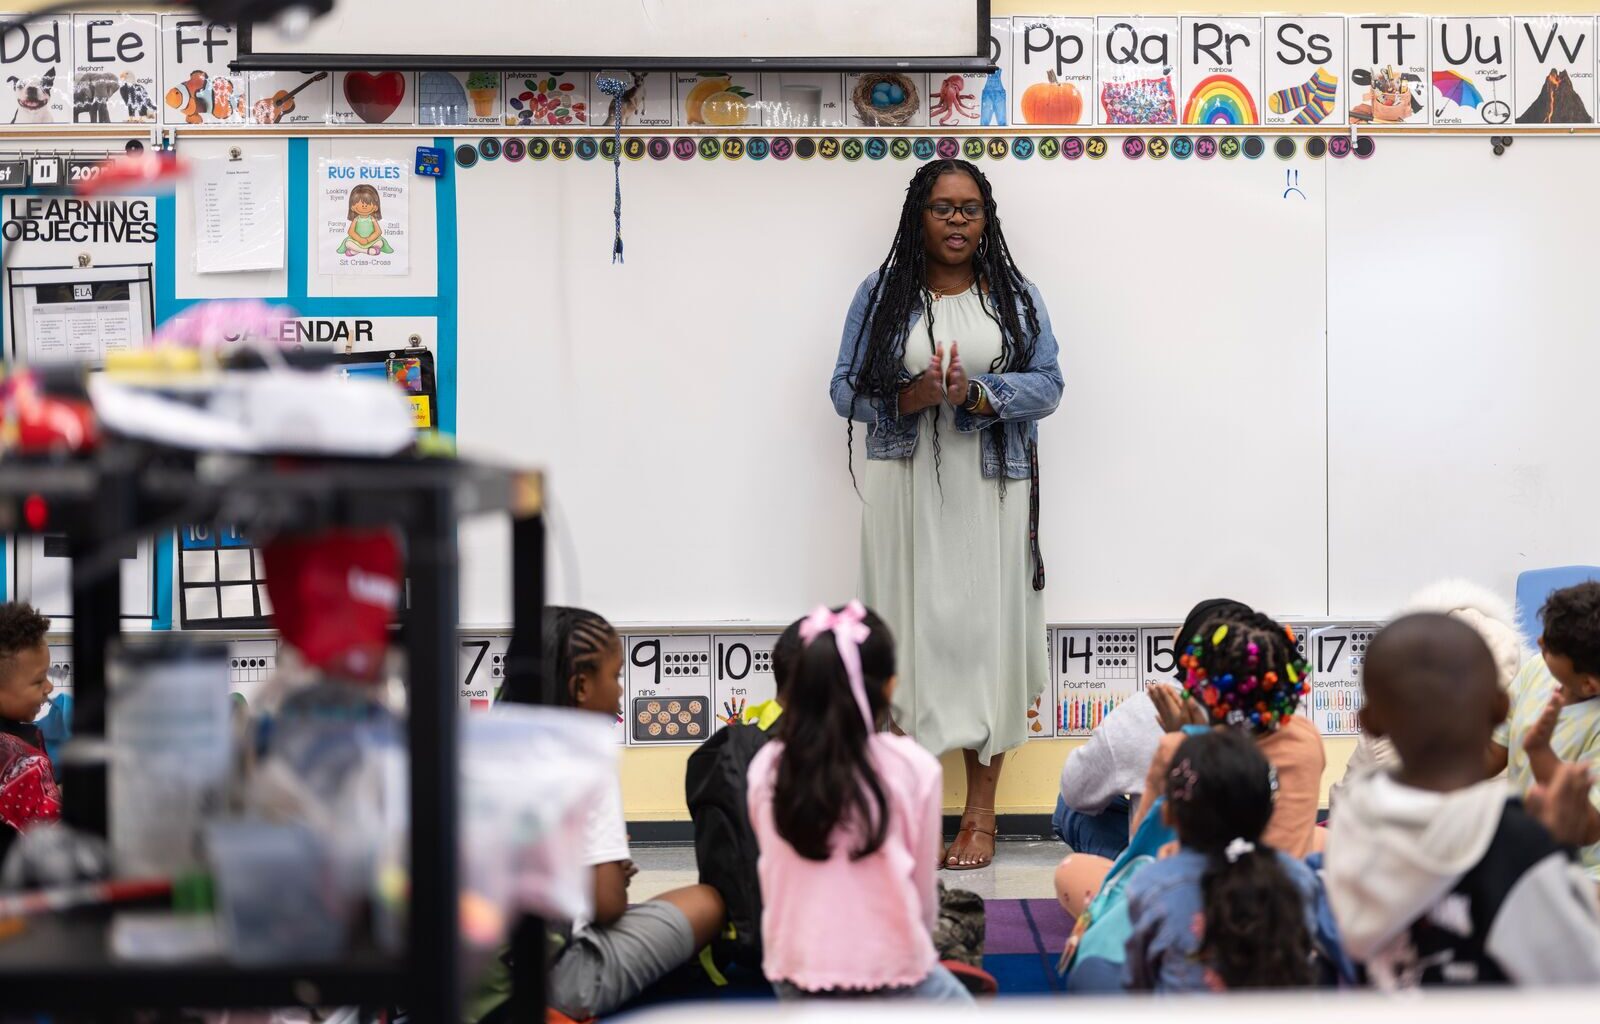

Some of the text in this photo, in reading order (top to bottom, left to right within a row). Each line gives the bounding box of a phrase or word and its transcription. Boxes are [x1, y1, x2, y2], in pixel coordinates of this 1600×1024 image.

[0, 20, 61, 64] Dd
[87, 20, 145, 63] Ee
[176, 21, 231, 64] Ff
[1024, 22, 1083, 76] Pp
[1193, 22, 1250, 65] Rr
[1276, 23, 1332, 65] Ss
[1360, 22, 1416, 66] Tt
[1441, 23, 1502, 65] Uu
[1523, 22, 1585, 63] Vv
[486, 143, 494, 154] 1
[509, 144, 519, 156] 2
[534, 142, 543, 154] 3
[558, 142, 566, 154] 4
[583, 142, 591, 153] 6
[606, 142, 615, 154] 7
[630, 142, 641, 154] 8
[655, 142, 662, 154] 9
[677, 142, 693, 154] 10
[702, 142, 717, 155] 11
[726, 142, 741, 155] 12
[750, 142, 764, 154] 13
[774, 141, 789, 156] 14
[845, 142, 861, 157] 15
[869, 140, 884, 155] 17
[894, 141, 908, 156] 19
[918, 142, 931, 155] 21
[941, 141, 955, 156] 22
[966, 142, 980, 154] 23
[990, 142, 1005, 155] 16
[1016, 139, 1030, 156] 25
[1041, 139, 1056, 155] 27
[1066, 140, 1080, 156] 18
[1090, 140, 1104, 155] 28
[1126, 140, 1141, 154] 30
[1150, 140, 1165, 156] 32
[1177, 140, 1190, 154] 33
[1199, 141, 1212, 154] 34
[1221, 139, 1237, 155] 35
[40, 165, 51, 178] 11
[328, 166, 400, 179] RUG RULES
[377, 185, 403, 193] Listening
[10, 198, 149, 222] LEARNING
[2, 220, 159, 243] OBJECTIVES
[75, 288, 91, 297] ELA
[718, 642, 751, 680] 10
[1061, 636, 1093, 674] 14
[1147, 635, 1176, 673] 15
[1318, 635, 1347, 672] 17
[462, 641, 490, 685] 7
[631, 639, 660, 684] 9
[730, 687, 747, 695] ten
[1063, 680, 1106, 688] fourteen
[638, 688, 656, 697] nine
